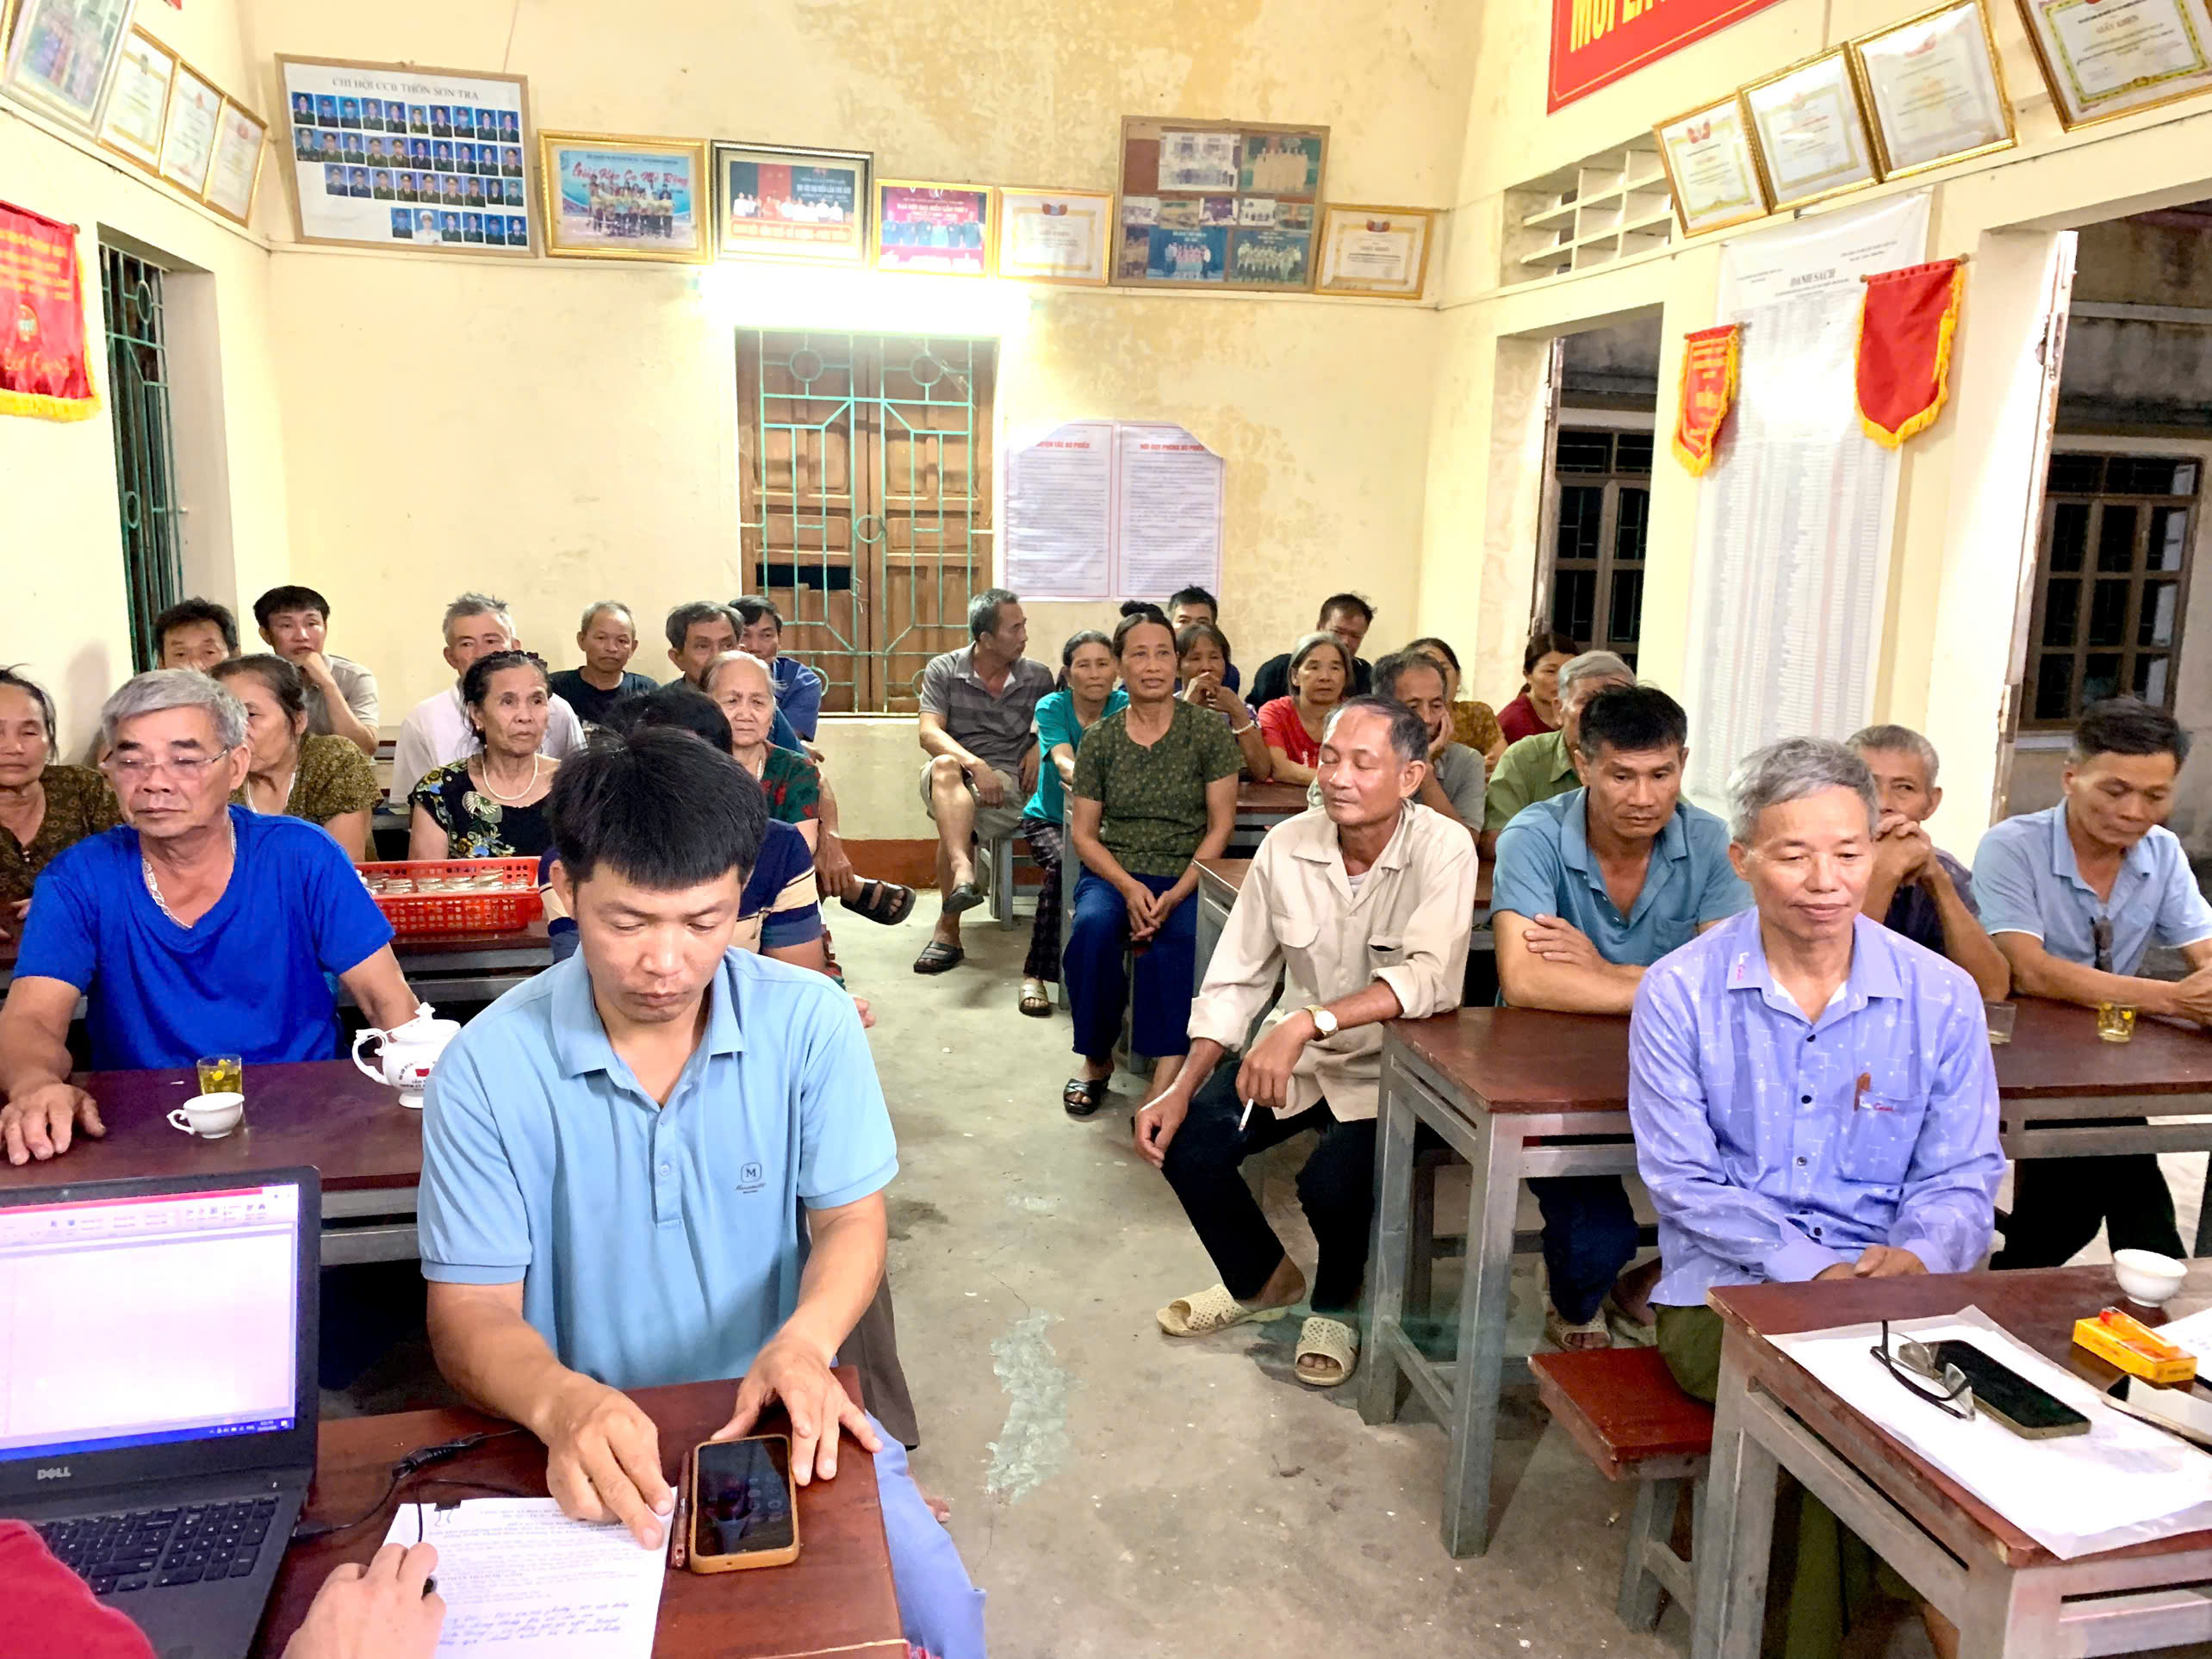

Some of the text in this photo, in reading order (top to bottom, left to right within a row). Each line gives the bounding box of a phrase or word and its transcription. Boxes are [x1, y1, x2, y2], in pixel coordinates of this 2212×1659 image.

[332, 78, 351, 87] CHI
[354, 79, 374, 90] HỘI
[376, 82, 398, 91] CCB
[745, 1168, 757, 1178] M
[37, 1466, 71, 1481] DELL
